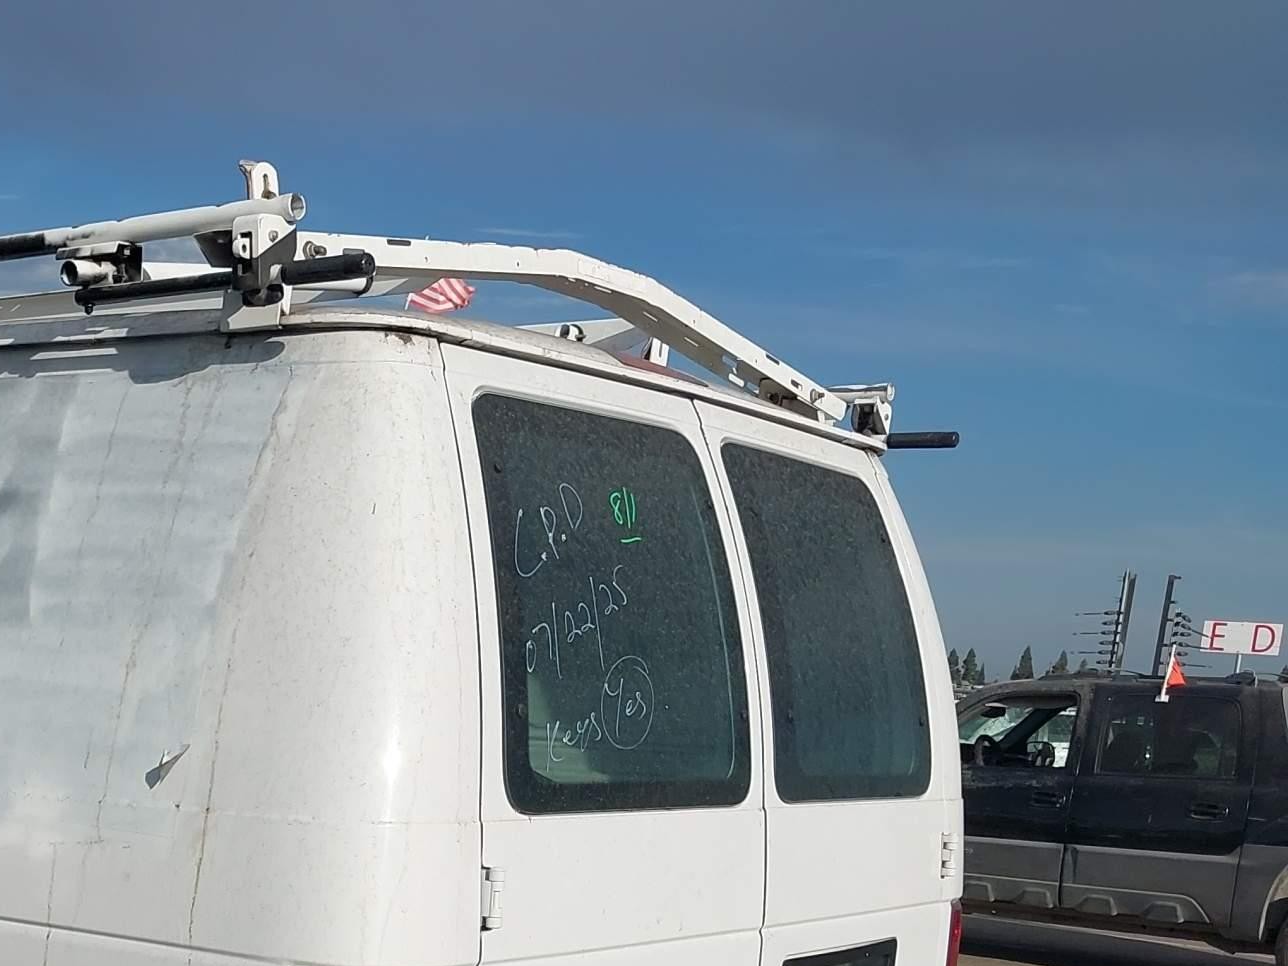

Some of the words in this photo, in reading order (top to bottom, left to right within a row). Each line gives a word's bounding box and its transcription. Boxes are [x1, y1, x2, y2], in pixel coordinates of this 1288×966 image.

[525, 565, 628, 679] 07/22/25
[546, 711, 602, 773] Keys
[604, 678, 647, 737] Yes
